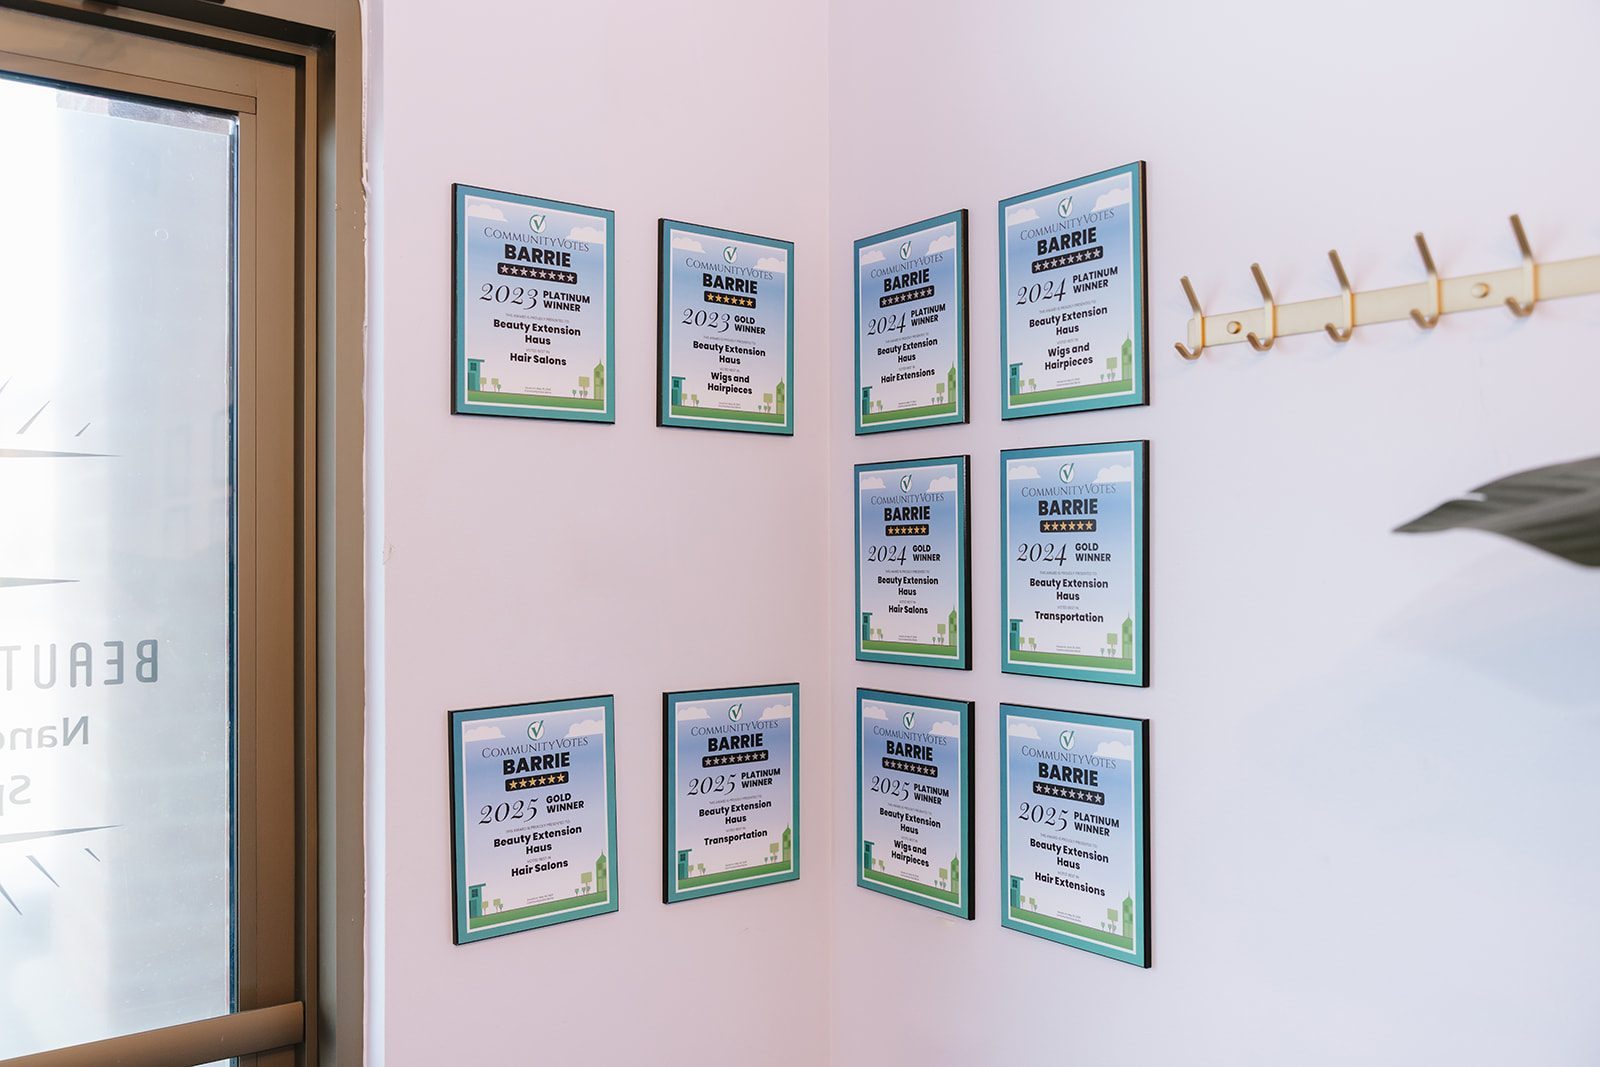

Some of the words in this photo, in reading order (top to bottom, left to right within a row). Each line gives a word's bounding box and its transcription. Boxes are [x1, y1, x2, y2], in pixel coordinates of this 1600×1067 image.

[1020, 208, 1115, 240] COMMUNITYVOTES
[484, 227, 589, 252] COMMUNITYVOTES
[1037, 227, 1096, 256] BARRIE
[505, 244, 571, 267] BARRIE
[686, 258, 773, 280] COMMUNITYVOTES
[871, 253, 943, 278] COMMUNITYVOTES
[703, 273, 757, 294] BARRIE
[884, 268, 929, 292] BARRIE
[1016, 278, 1065, 305] 2024
[1073, 267, 1118, 283] PLATINUM
[1073, 279, 1108, 293] WINNER
[479, 283, 538, 311] 2023
[543, 291, 590, 304] PLATINUM
[544, 300, 581, 312] WINNER
[682, 308, 730, 333] 2023
[735, 315, 755, 324] GOLD
[867, 312, 906, 336] 2024
[911, 304, 946, 318] PLATINUM
[911, 315, 939, 327] WINNER
[1029, 314, 1060, 328] Beauty
[1062, 306, 1107, 322] Extension
[494, 319, 530, 333] Beauty
[532, 323, 581, 336] Extension
[735, 324, 766, 334] WINNER
[1056, 325, 1079, 335] Haus
[525, 335, 551, 345] Haus
[693, 341, 724, 353] Beauty
[725, 345, 766, 356] Extension
[878, 345, 901, 355] Beauty
[903, 338, 938, 351] Extension
[898, 354, 916, 363] Haus
[1048, 345, 1070, 358] Wigs
[1072, 342, 1090, 352] and
[510, 353, 532, 363] Hair
[533, 355, 567, 366] Salons
[719, 356, 741, 364] Haus
[1045, 357, 1093, 370] Hairpieces
[711, 372, 732, 383] Wigs
[881, 374, 895, 383] Hair
[896, 368, 935, 381] Extensions
[708, 383, 752, 394] Hairpieces
[871, 493, 944, 505] COMMUNITYVOTES
[1021, 484, 1117, 498] COMMUNITYVOTES
[884, 506, 930, 521] BARRIE
[1038, 499, 1098, 516] BARRIE
[868, 545, 907, 566] 2024
[1017, 543, 1067, 566] 2024
[1075, 543, 1098, 551] GOLD
[1075, 554, 1111, 562] WINNER
[878, 576, 902, 586] Beauty
[903, 576, 938, 584] Extension
[1030, 578, 1061, 590] Beauty
[1063, 578, 1108, 588] Extension
[1056, 592, 1080, 600] Haus
[889, 605, 903, 613] Hair
[904, 606, 928, 614] Salons
[1035, 611, 1104, 623] Transportation
[691, 720, 779, 736] COMMUNITYVOTES
[873, 726, 947, 746] COMMUNITYVOTES
[482, 737, 589, 759] COMMUNITYVOTES
[708, 733, 763, 752] BARRIE
[887, 740, 933, 761] BARRIE
[503, 752, 570, 775] BARRIE
[1022, 745, 1117, 770] COMMUNITYVOTES
[688, 774, 736, 796] 2025
[741, 768, 780, 779] PLATINUM
[742, 778, 773, 788] WINNER
[1038, 762, 1098, 787] BARRIE
[871, 776, 910, 801] 2025
[914, 783, 949, 797] PLATINUM
[547, 801, 584, 814] WINNER
[914, 793, 942, 805] WINNER
[479, 798, 539, 824] 2025
[546, 793, 571, 804] GOLD
[699, 806, 730, 817] Beauty
[731, 800, 771, 813] Extension
[1019, 802, 1068, 831] 2025
[1074, 811, 1120, 828] PLATINUM
[725, 816, 747, 824] Haus
[880, 808, 904, 822] Beauty
[905, 814, 941, 828] Extension
[494, 834, 531, 848] Beauty
[533, 825, 582, 841] Extension
[704, 829, 768, 846] Transportation
[900, 824, 918, 834] Haus
[1074, 822, 1110, 837] WINNER
[526, 843, 552, 854] Haus
[894, 840, 912, 852] Wigs
[912, 846, 926, 855] and
[1030, 838, 1062, 855] Beauty
[1063, 845, 1109, 863] Extension
[892, 851, 929, 867] Hairpieces
[1057, 857, 1080, 870] Haus
[511, 866, 533, 877] Hair
[535, 859, 568, 873] Salons
[1035, 872, 1054, 883] Hair
[1055, 876, 1105, 896] Extensions
